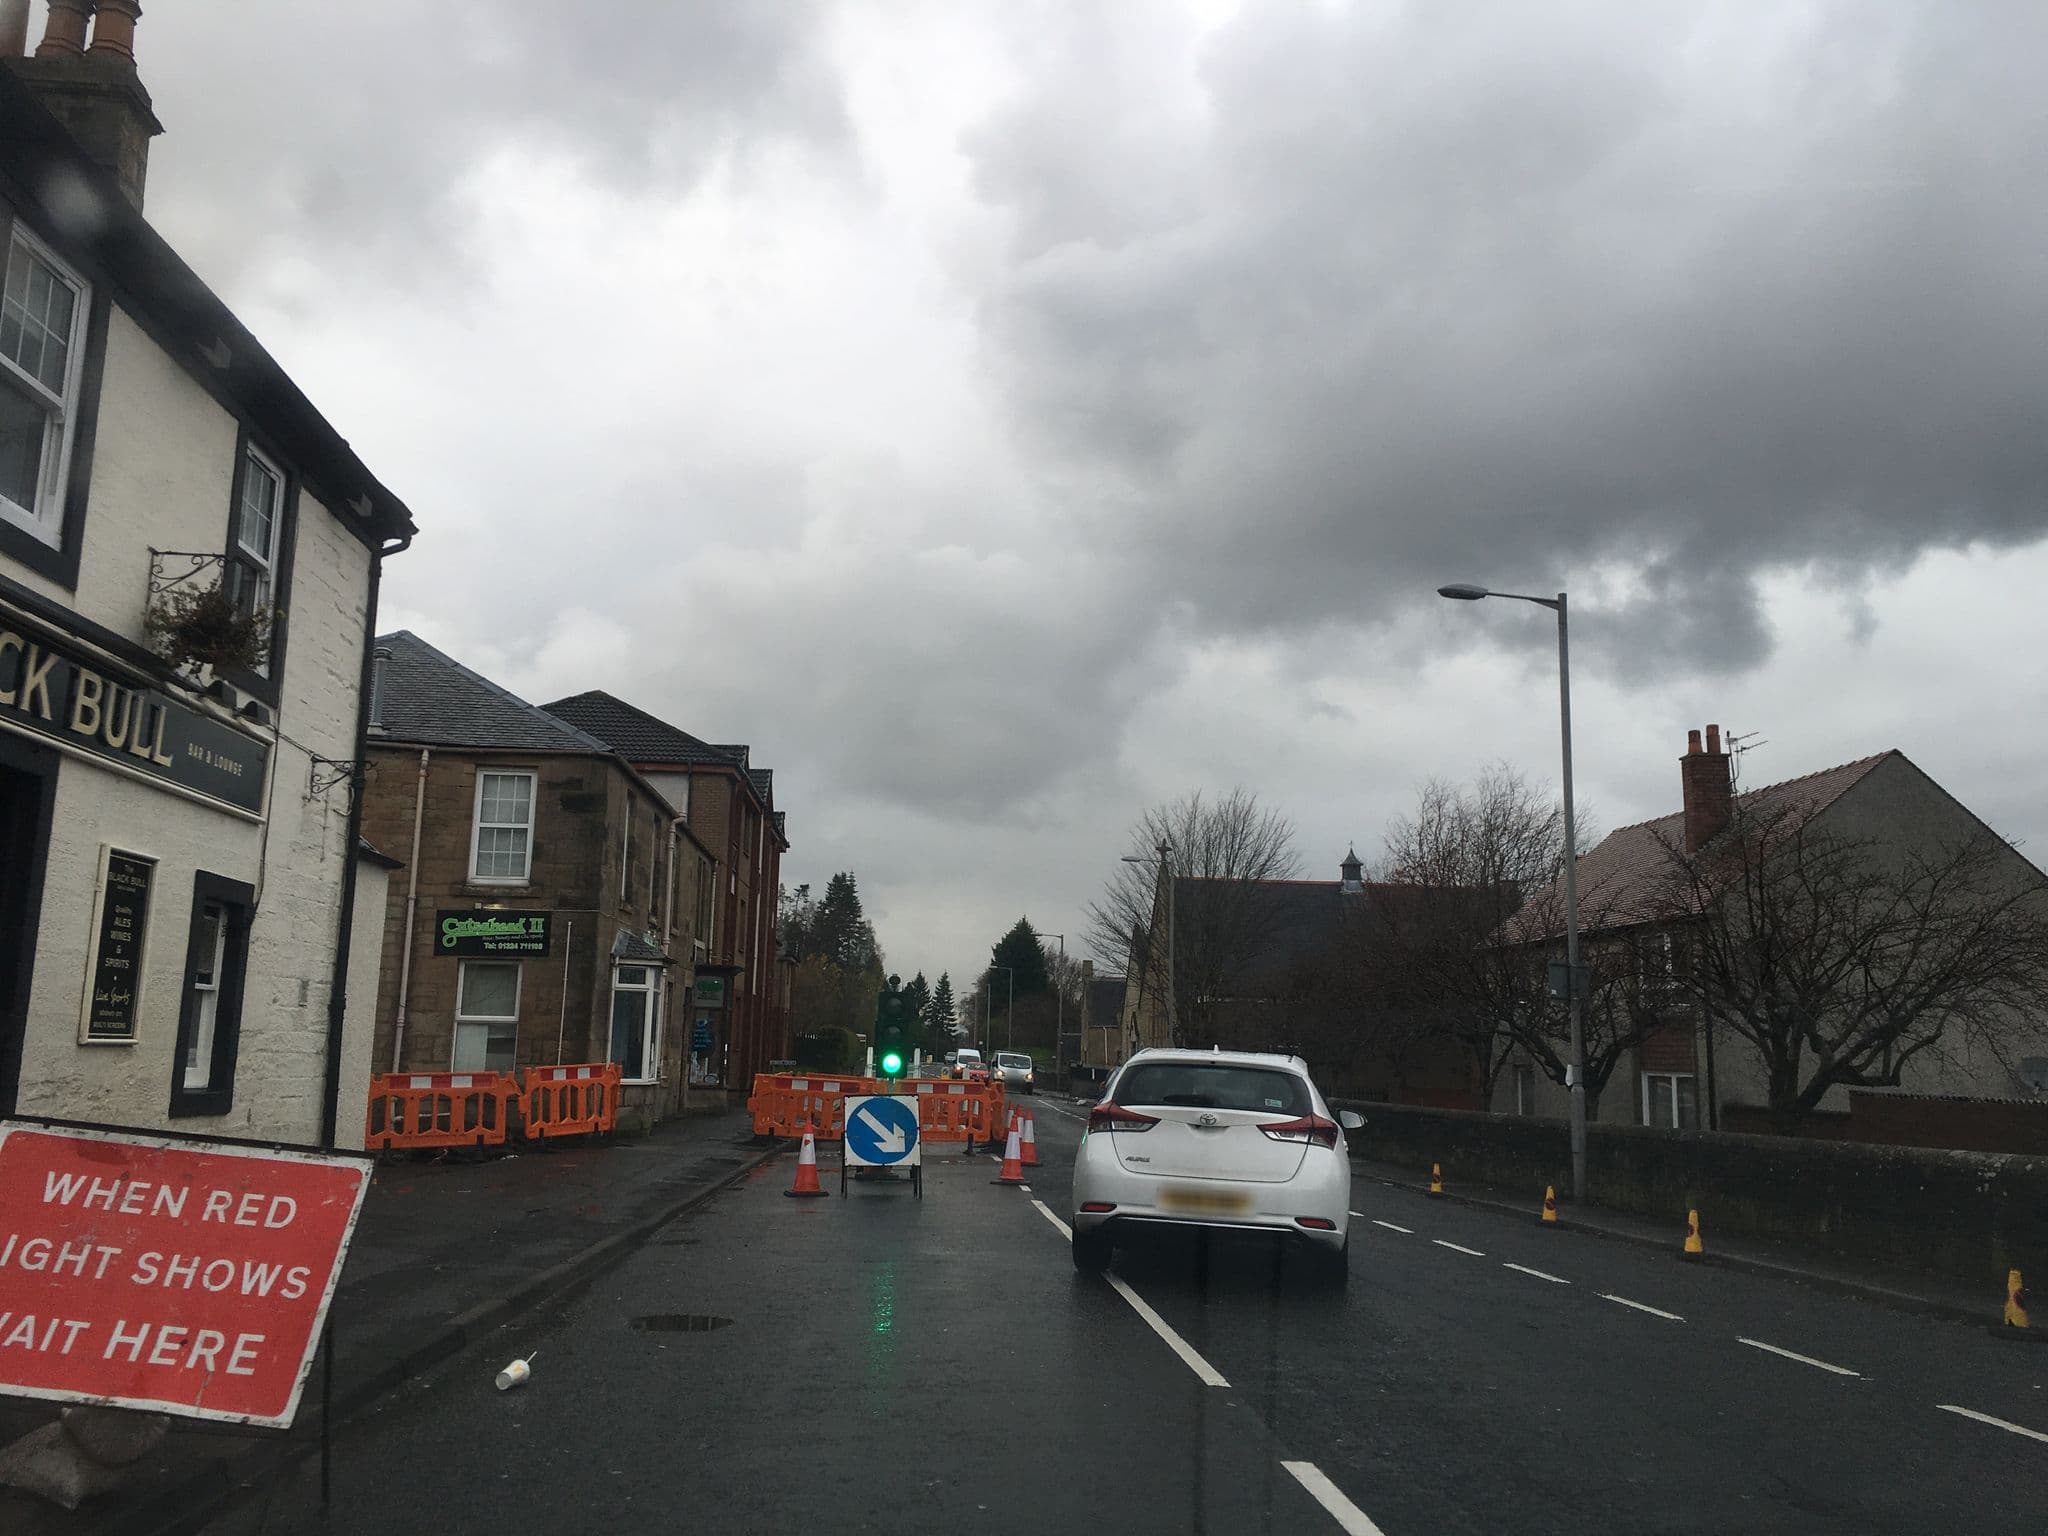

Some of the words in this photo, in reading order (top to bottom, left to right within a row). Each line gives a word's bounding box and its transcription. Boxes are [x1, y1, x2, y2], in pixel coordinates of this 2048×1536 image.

[69, 666, 173, 768] BULL
[188, 743, 203, 760] BAR
[214, 754, 243, 777] LOUNGE
[113, 916, 132, 928] ALES
[43, 1170, 189, 1219] WHEN
[202, 1190, 297, 1229] RED
[0, 1233, 122, 1280] IGHT
[131, 1251, 312, 1300] SHOWS
[103, 1319, 267, 1376] HERE
